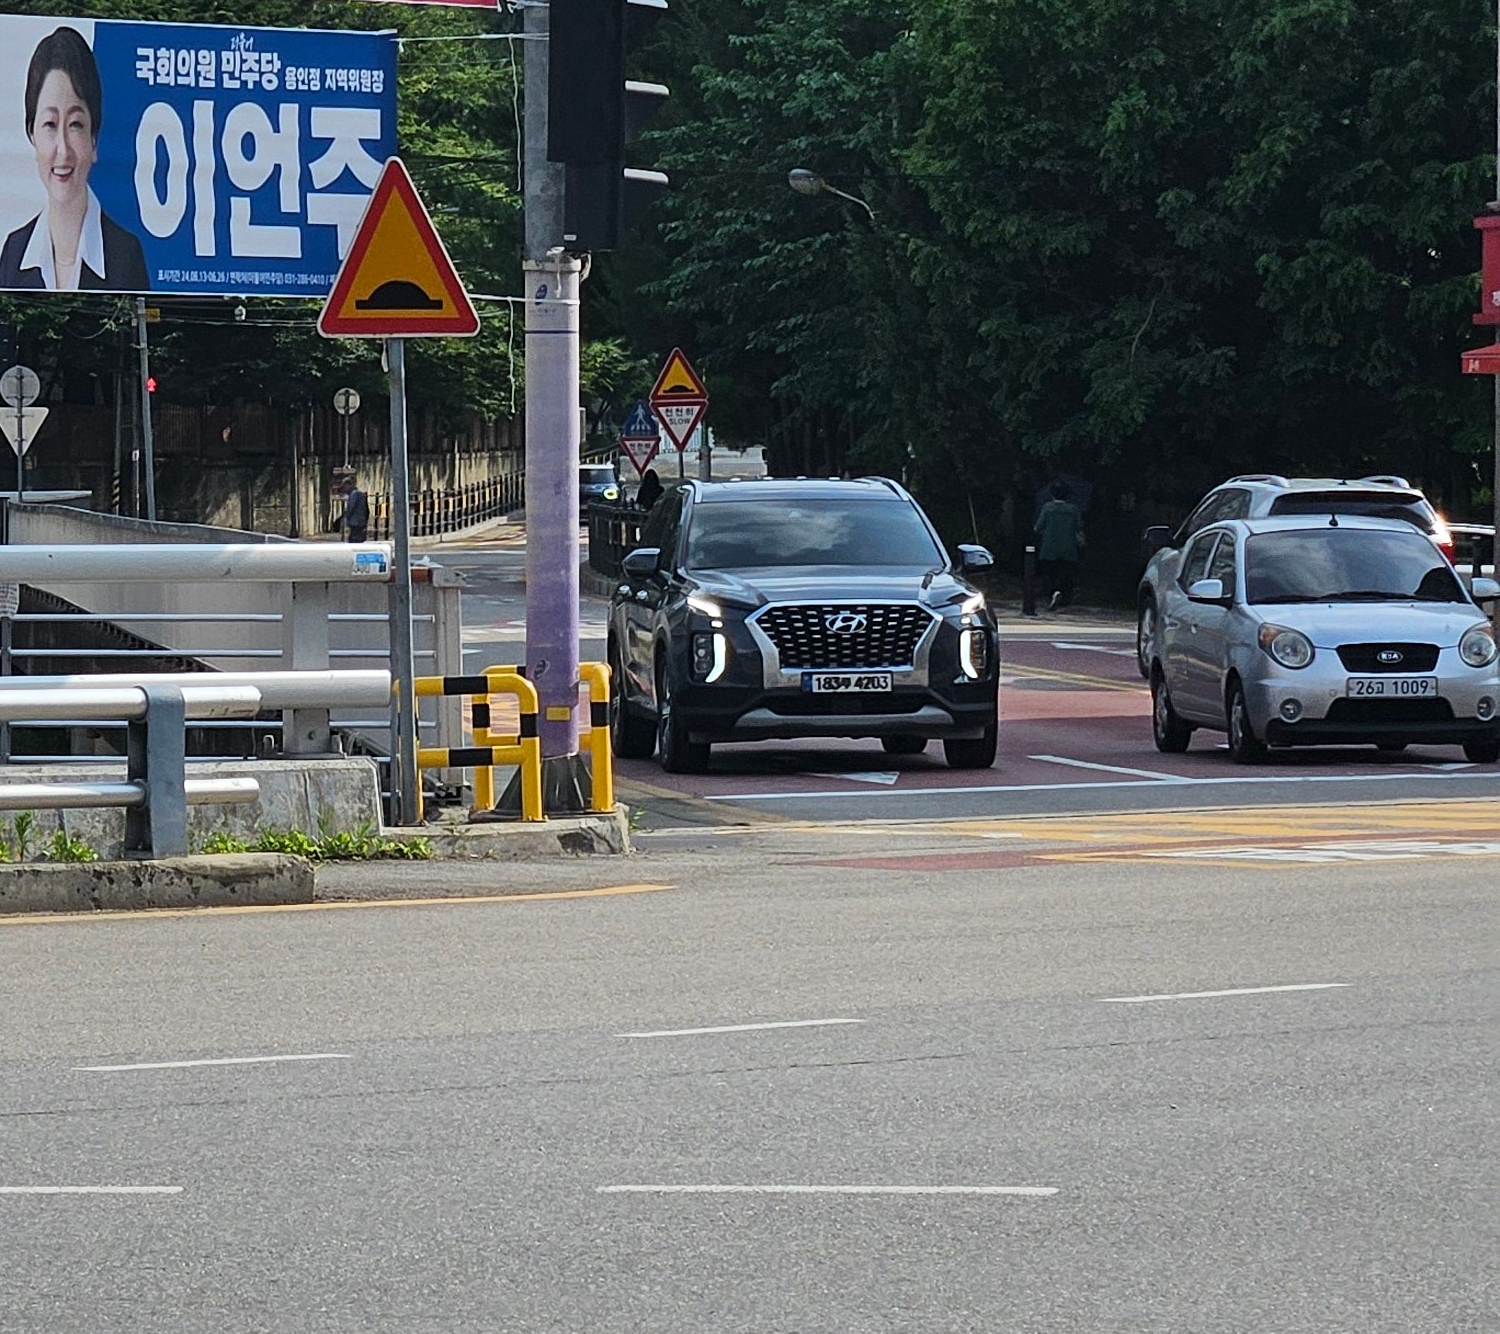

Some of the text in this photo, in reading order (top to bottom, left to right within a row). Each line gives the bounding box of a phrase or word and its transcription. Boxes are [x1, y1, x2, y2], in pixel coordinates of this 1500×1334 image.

[135, 47, 384, 93] 국회의원 민주당 용인정 지역위원장
[134, 100, 385, 260] 이언주
[665, 407, 694, 417] 천천히
[669, 417, 691, 426] SLOW
[1392, 679, 1429, 695] 1009
